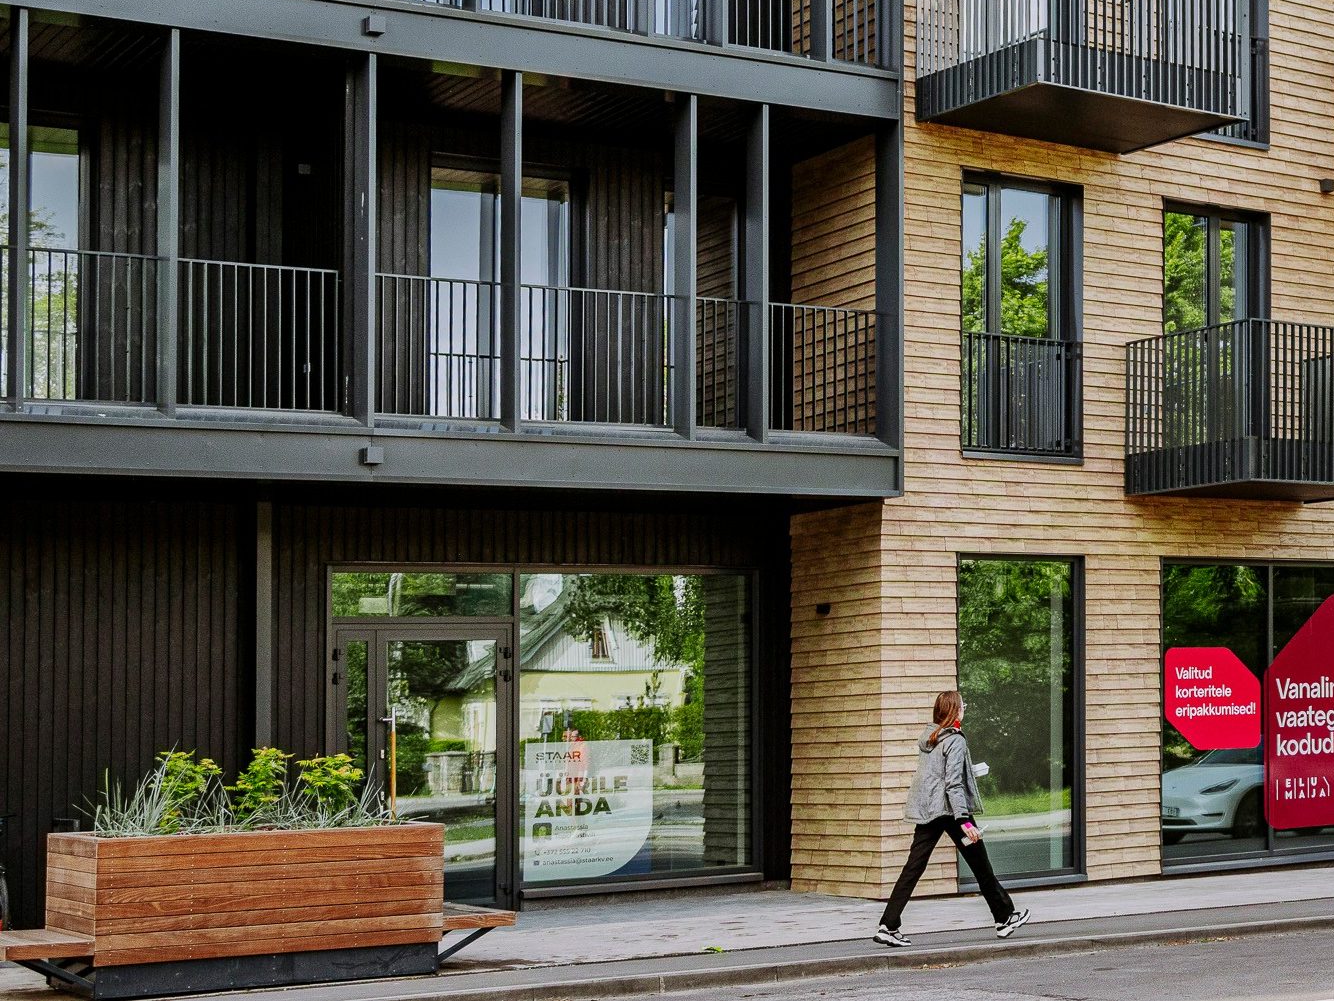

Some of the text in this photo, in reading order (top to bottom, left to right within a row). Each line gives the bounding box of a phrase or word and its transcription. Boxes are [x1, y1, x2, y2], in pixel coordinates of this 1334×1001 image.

[1175, 665, 1212, 680] Valitud
[1175, 684, 1232, 699] korteritele
[1175, 701, 1256, 720] eripakkumised!
[1276, 731, 1334, 757] kodud
[535, 750, 582, 761] STAAR
[534, 797, 612, 818] ANDA
